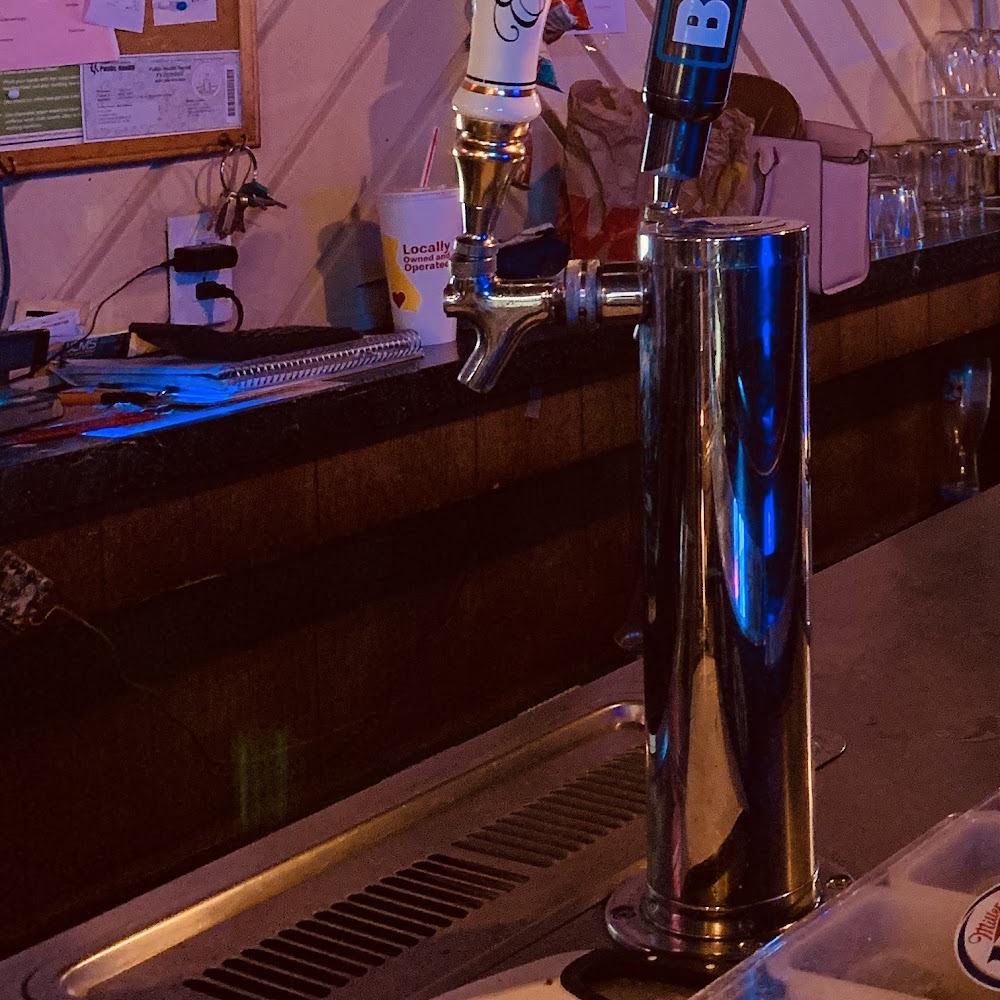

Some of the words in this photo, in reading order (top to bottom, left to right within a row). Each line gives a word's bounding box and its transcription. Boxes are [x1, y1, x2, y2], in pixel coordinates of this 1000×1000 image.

[402, 240, 451, 255] Locally
[403, 254, 434, 263] Owned
[435, 252, 451, 262] and
